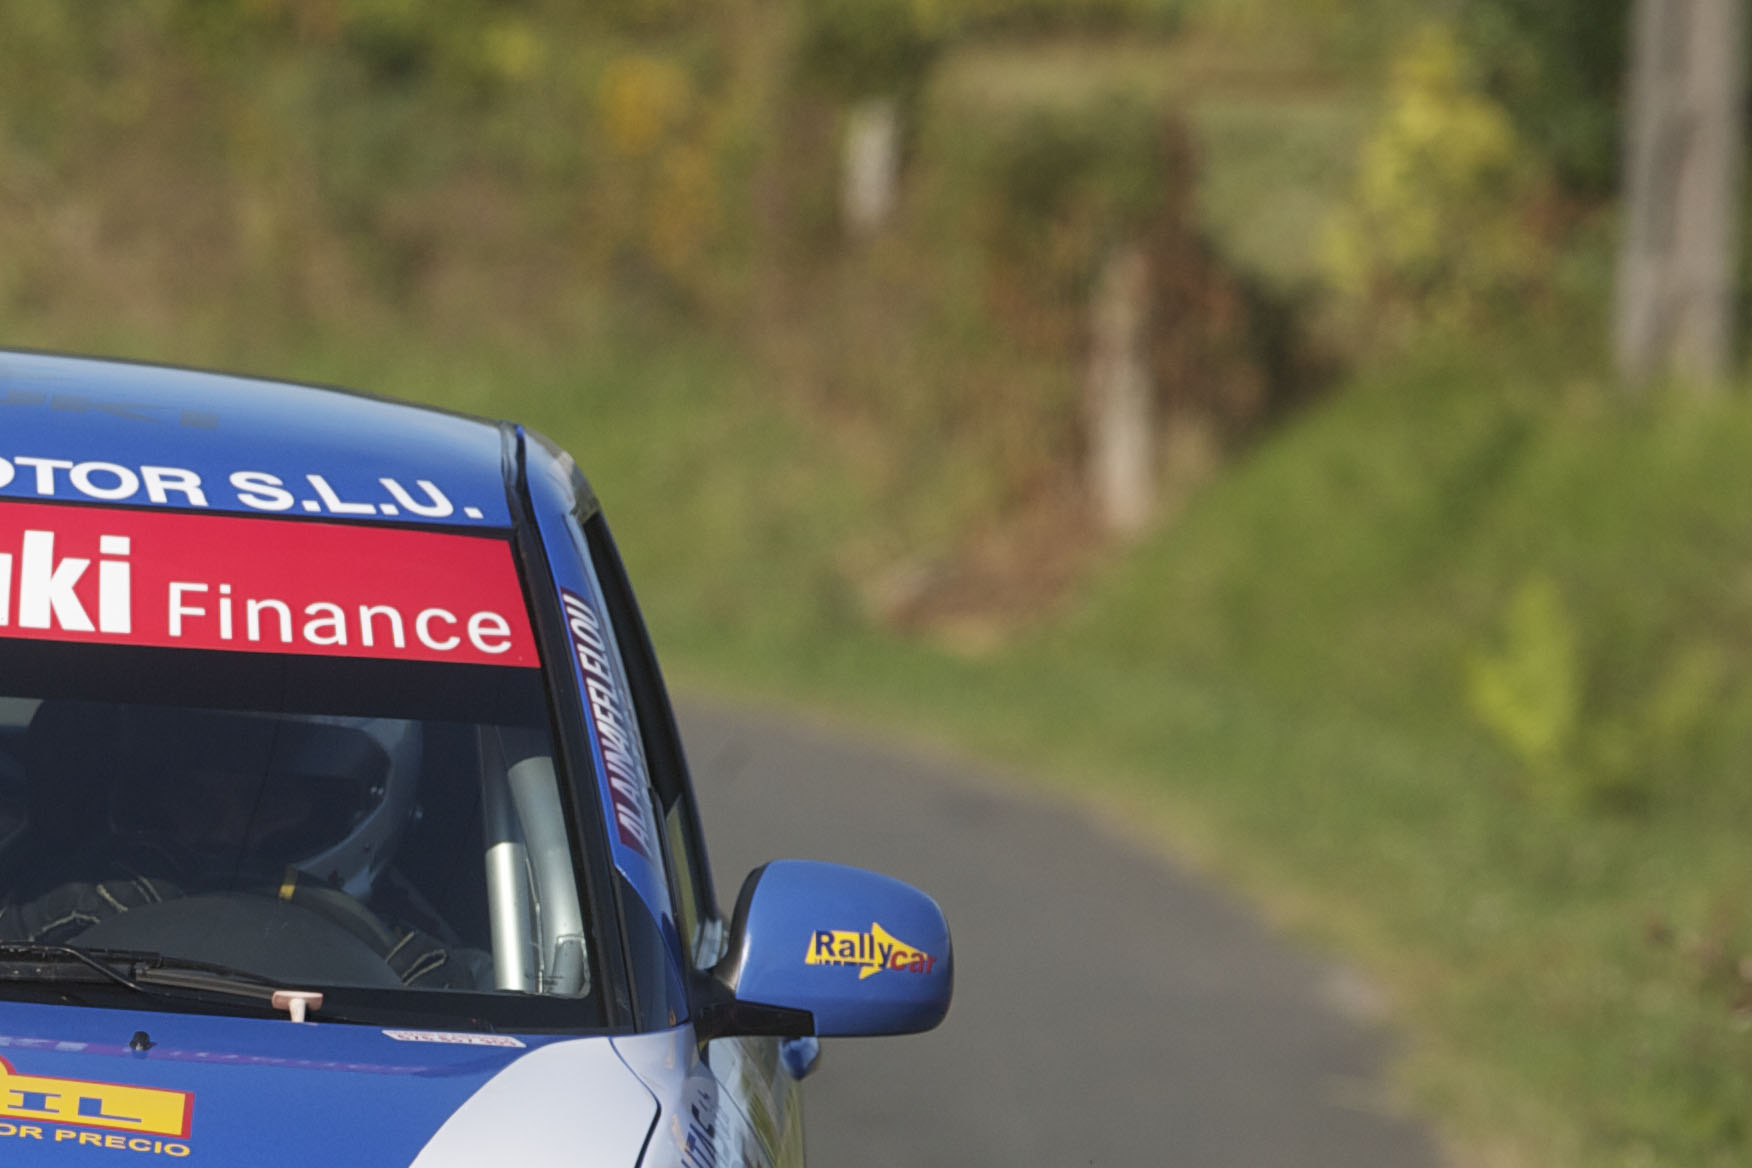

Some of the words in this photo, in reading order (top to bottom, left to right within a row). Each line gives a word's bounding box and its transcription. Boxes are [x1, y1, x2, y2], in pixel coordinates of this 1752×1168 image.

[229, 471, 484, 519] S.L.U.
[167, 580, 513, 655] Finance
[814, 929, 937, 974] Rallycar
[54, 1129, 192, 1158] PRECIO
